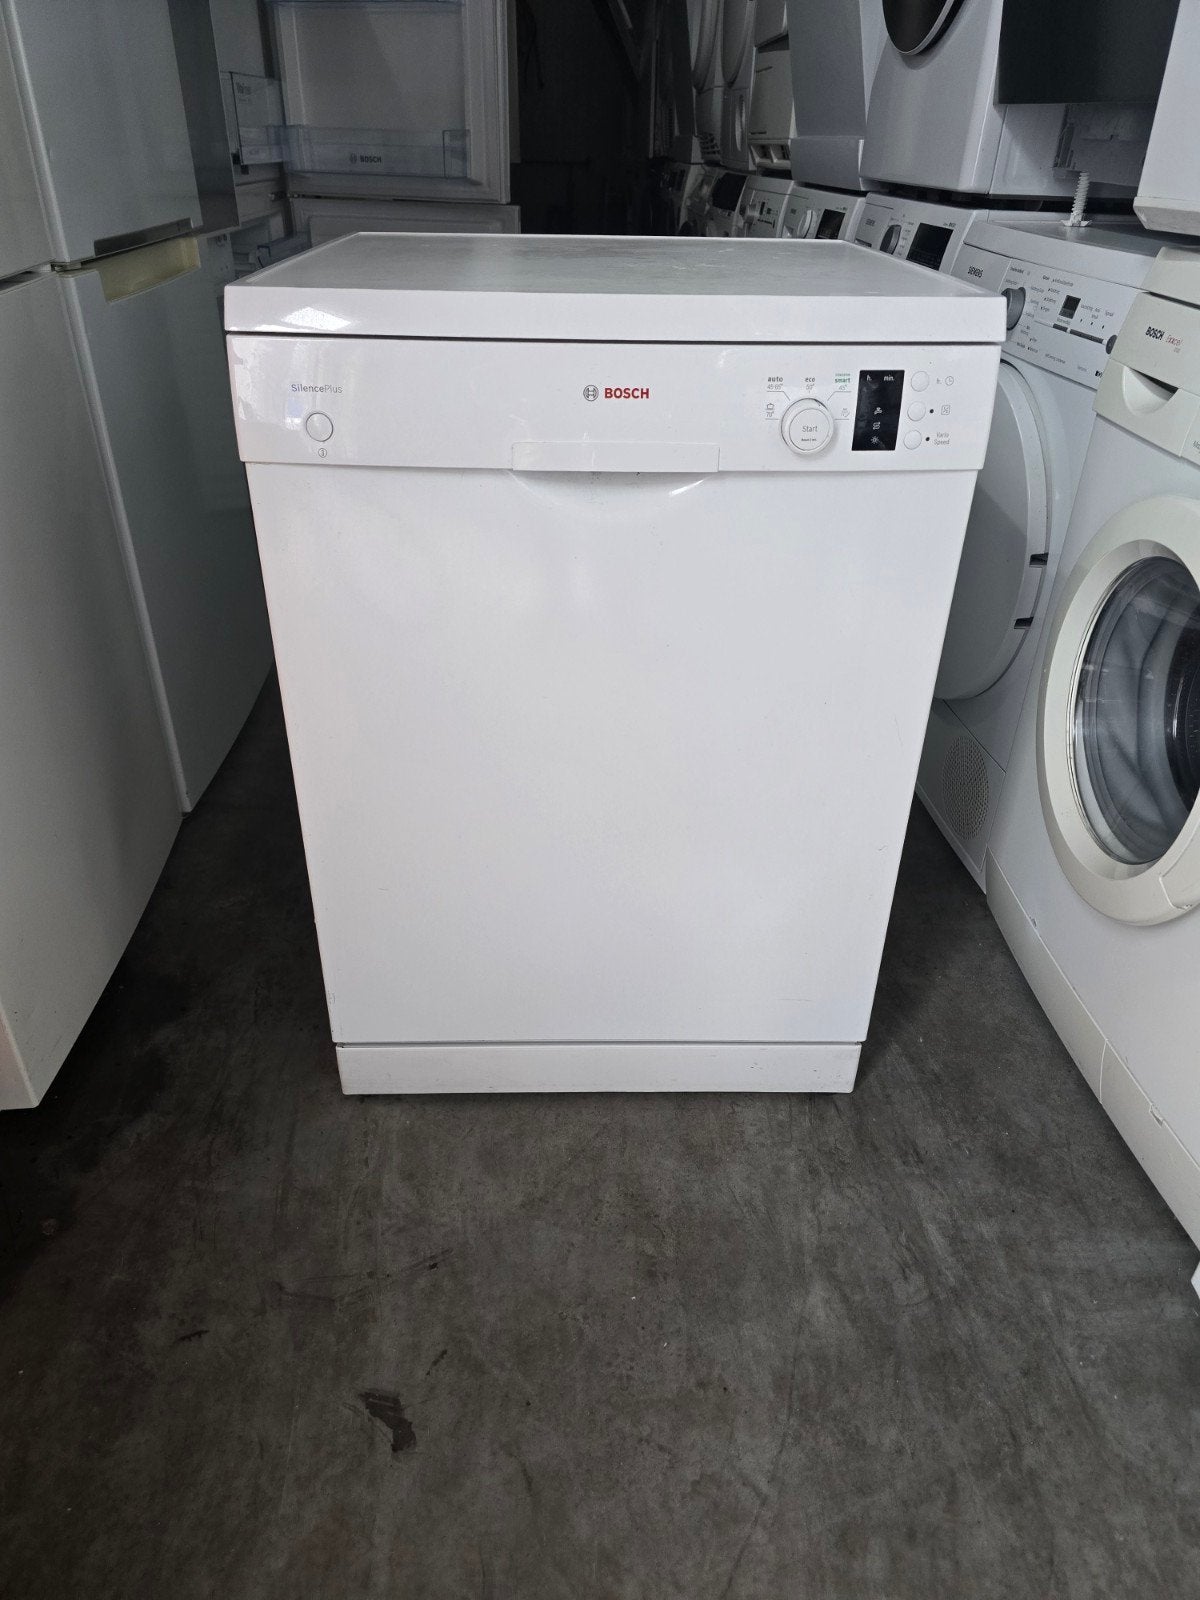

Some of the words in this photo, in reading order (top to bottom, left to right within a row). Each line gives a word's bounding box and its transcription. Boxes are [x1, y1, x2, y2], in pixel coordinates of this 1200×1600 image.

[359, 155, 382, 163] BOSCH
[1145, 326, 1165, 341] BOSCH
[291, 383, 343, 394] SilencePlus
[604, 387, 650, 399] BOSCH
[801, 425, 818, 433] Start
[933, 438, 951, 446] Speed
